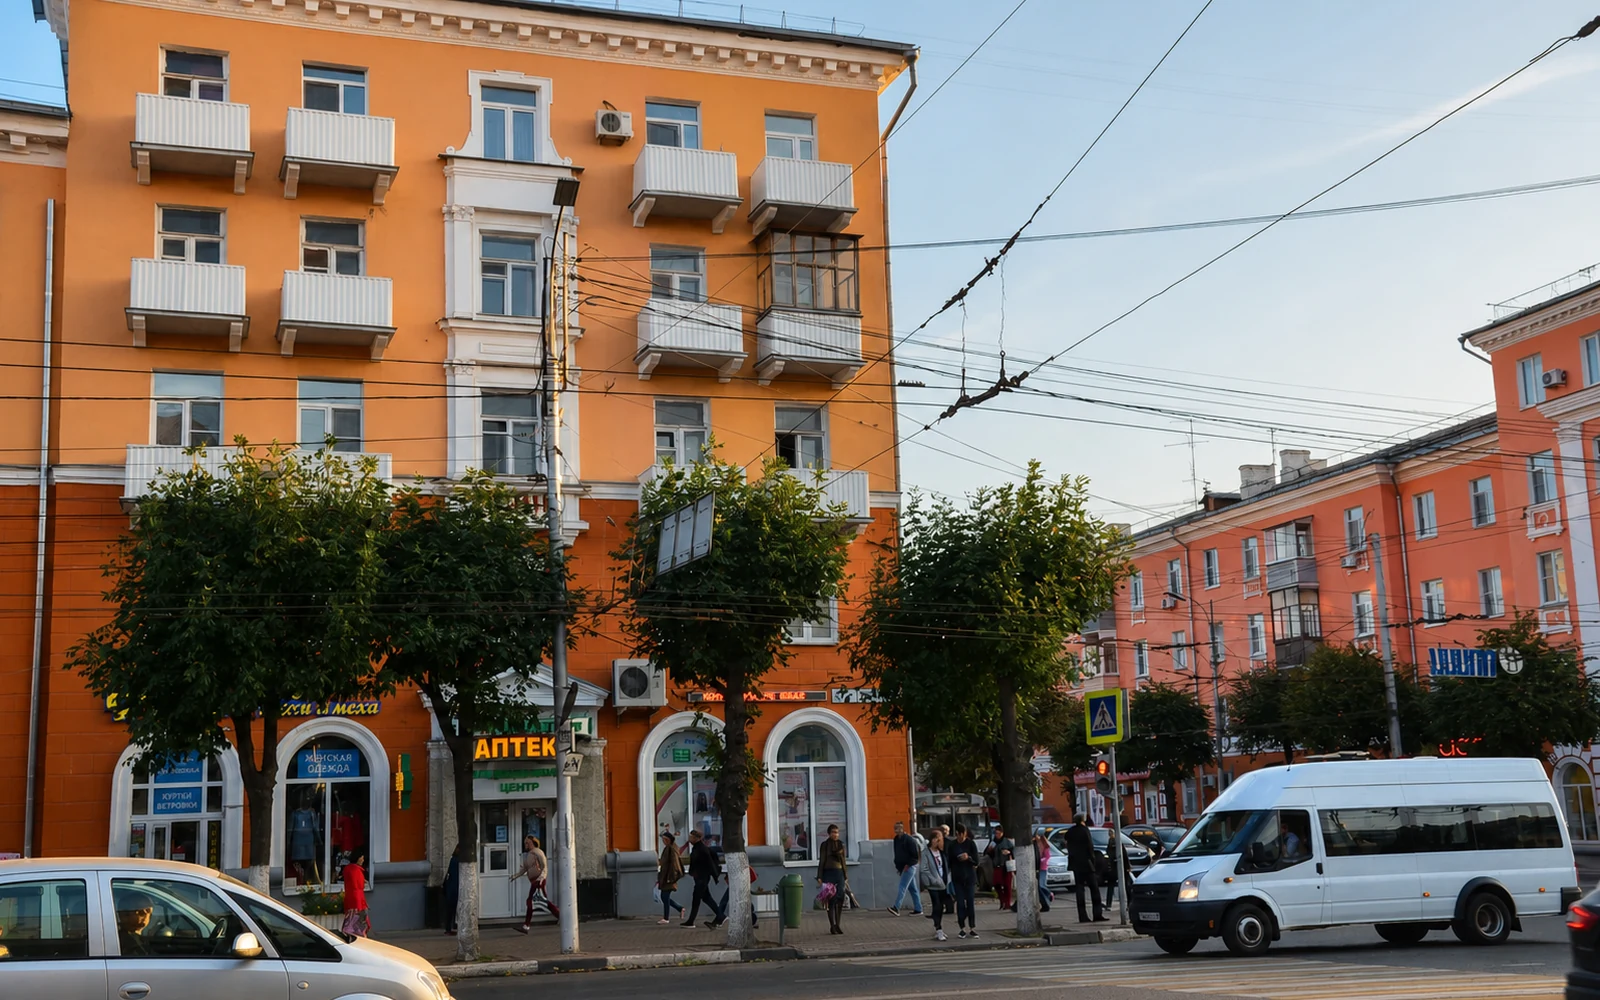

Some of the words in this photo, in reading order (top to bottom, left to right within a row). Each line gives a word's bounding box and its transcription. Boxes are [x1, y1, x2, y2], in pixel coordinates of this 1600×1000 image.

[332, 702, 379, 715] меха
[474, 736, 556, 760] АПТЕК
[307, 764, 350, 774] ОДЕЖДА
[500, 782, 540, 794] ЦЕНТР
[162, 792, 192, 801] КУРТКИ
[156, 801, 198, 811] ВЕТРОВКИ
